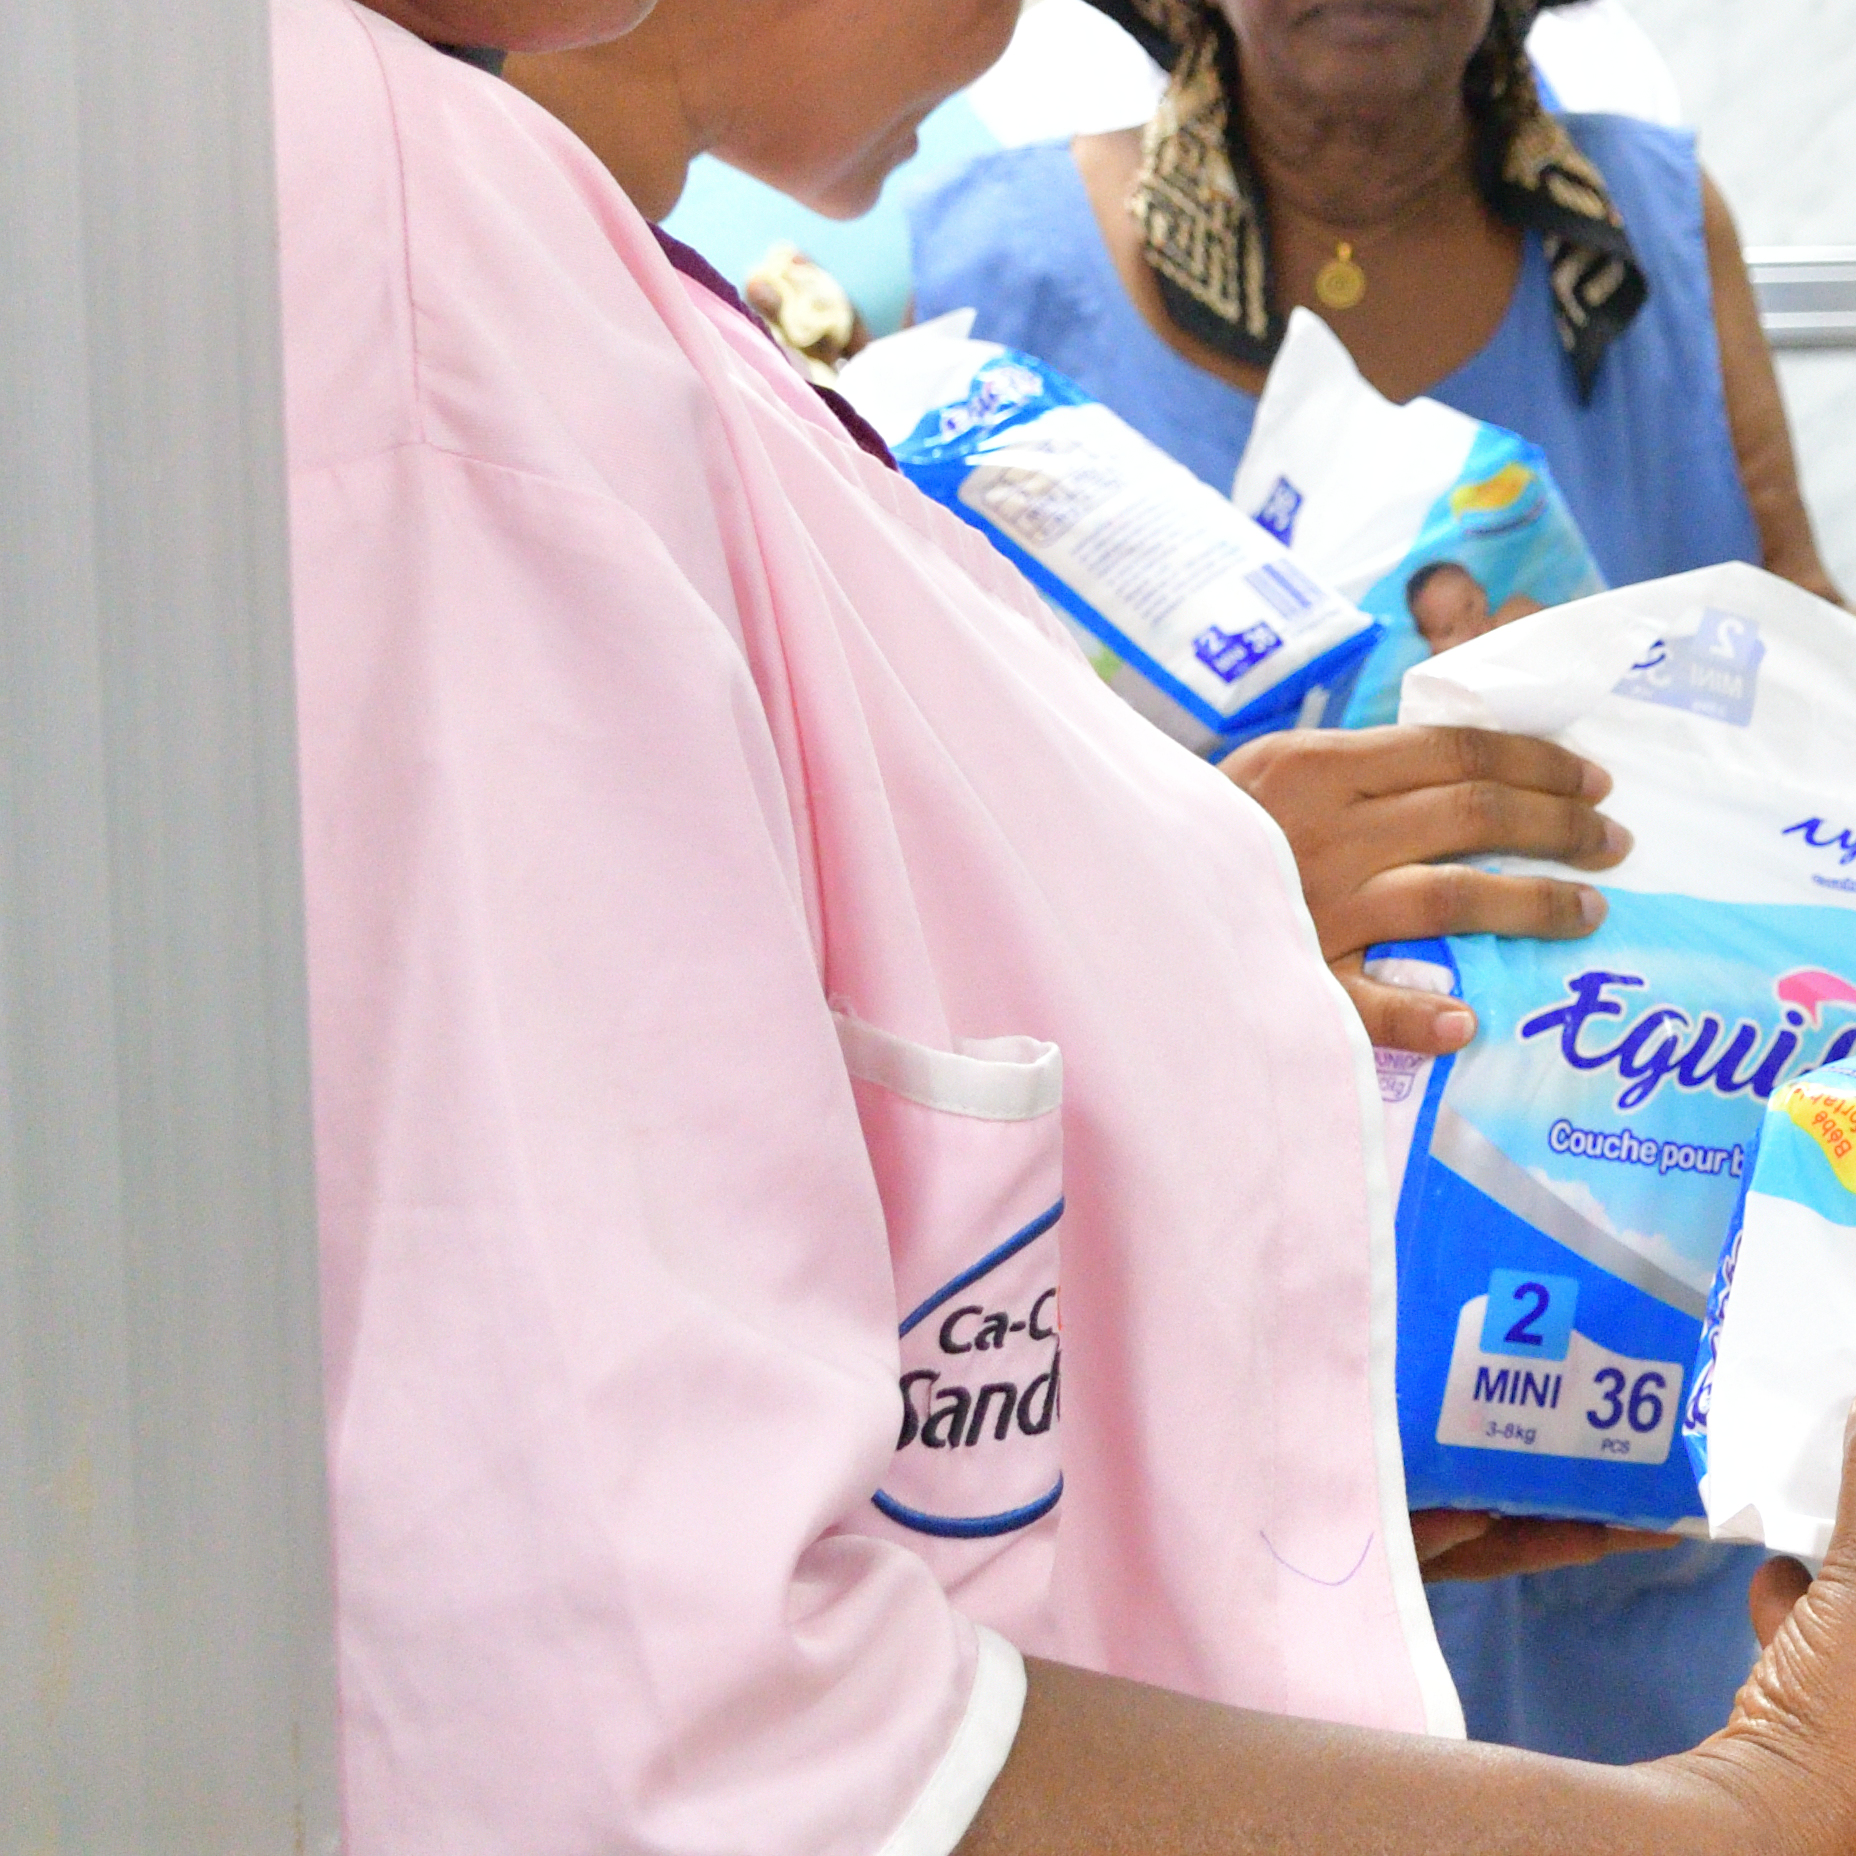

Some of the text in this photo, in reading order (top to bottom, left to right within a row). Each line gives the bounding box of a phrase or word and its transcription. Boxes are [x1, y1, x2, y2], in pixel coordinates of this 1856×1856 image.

[1549, 1119, 1658, 1166] Couche
[1660, 1142, 1728, 1175] pour
[1503, 1281, 1549, 1346] 2
[1473, 1366, 1562, 1410] MINI
[1586, 1367, 1666, 1433] 36
[1485, 1420, 1537, 1444] 3-8kg
